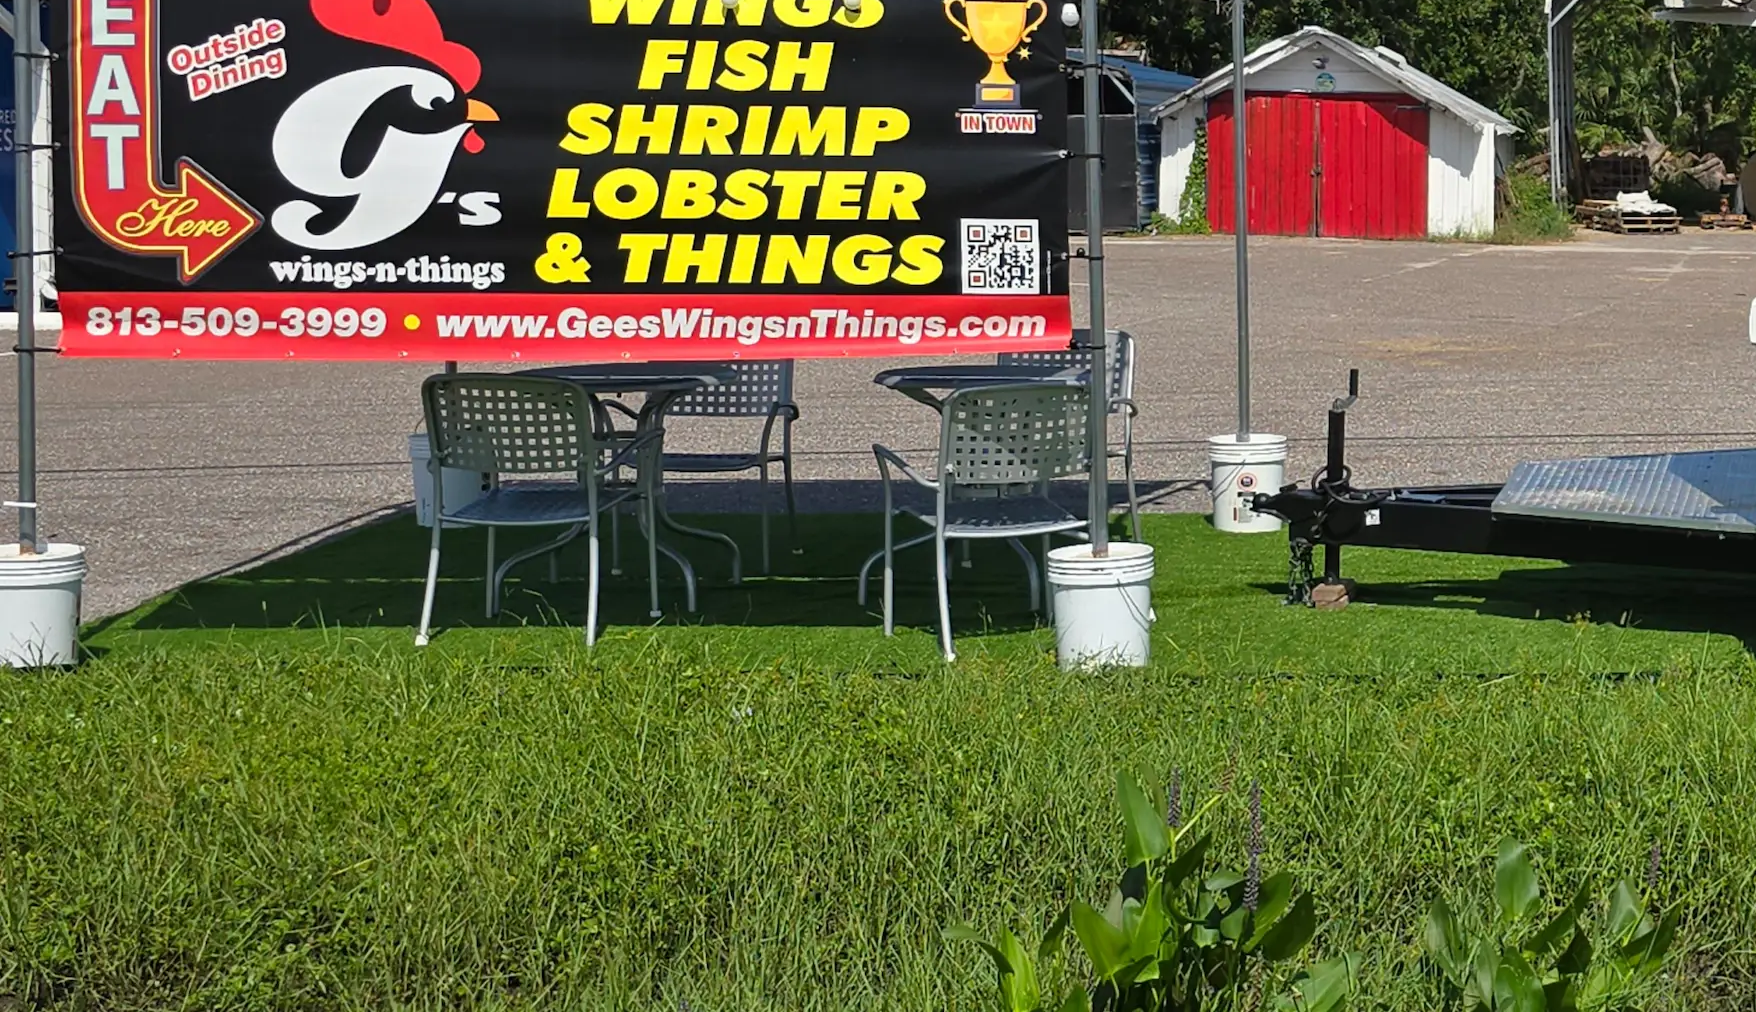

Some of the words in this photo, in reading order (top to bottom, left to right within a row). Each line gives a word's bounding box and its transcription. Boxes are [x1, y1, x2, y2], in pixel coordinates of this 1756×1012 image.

[169, 19, 284, 73] Outside
[638, 40, 833, 91] FISH
[189, 50, 285, 98] Dining
[561, 103, 909, 156] SHRIMP
[962, 114, 981, 131] IN
[985, 115, 1034, 132] TOWN
[547, 168, 926, 219] LOBSTER
[116, 199, 231, 239] Here
[269, 255, 505, 289] wings-n-things
[535, 233, 589, 283] &
[619, 234, 943, 285] THINGS
[86, 307, 386, 337] 813-509-3999
[437, 307, 1046, 345] www.GeesWingsnThings.com
